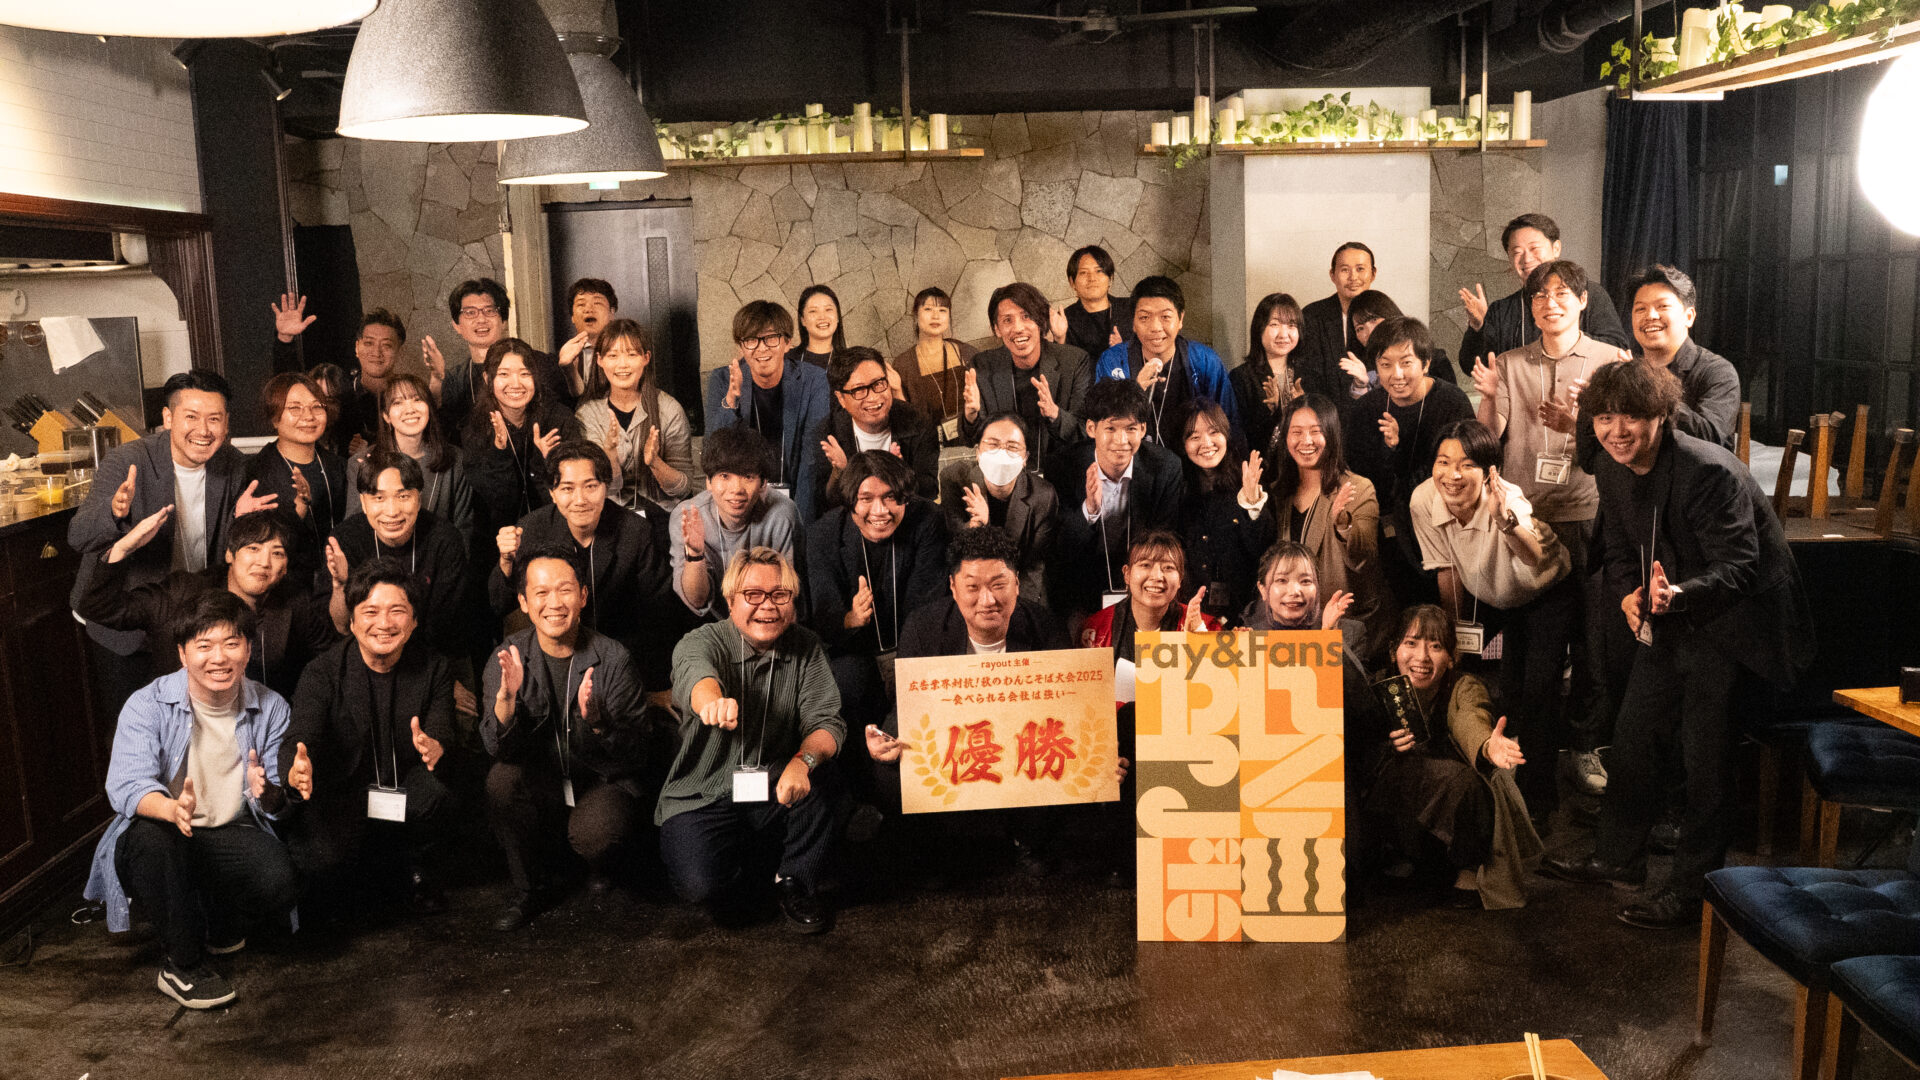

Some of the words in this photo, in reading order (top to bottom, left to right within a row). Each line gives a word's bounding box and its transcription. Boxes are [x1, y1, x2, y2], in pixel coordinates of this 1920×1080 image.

[981, 659, 1011, 671] rayout
[1014, 657, 1030, 667] 主催
[1135, 631, 1343, 681] ray&Fans
[942, 717, 1077, 786] 優勝
